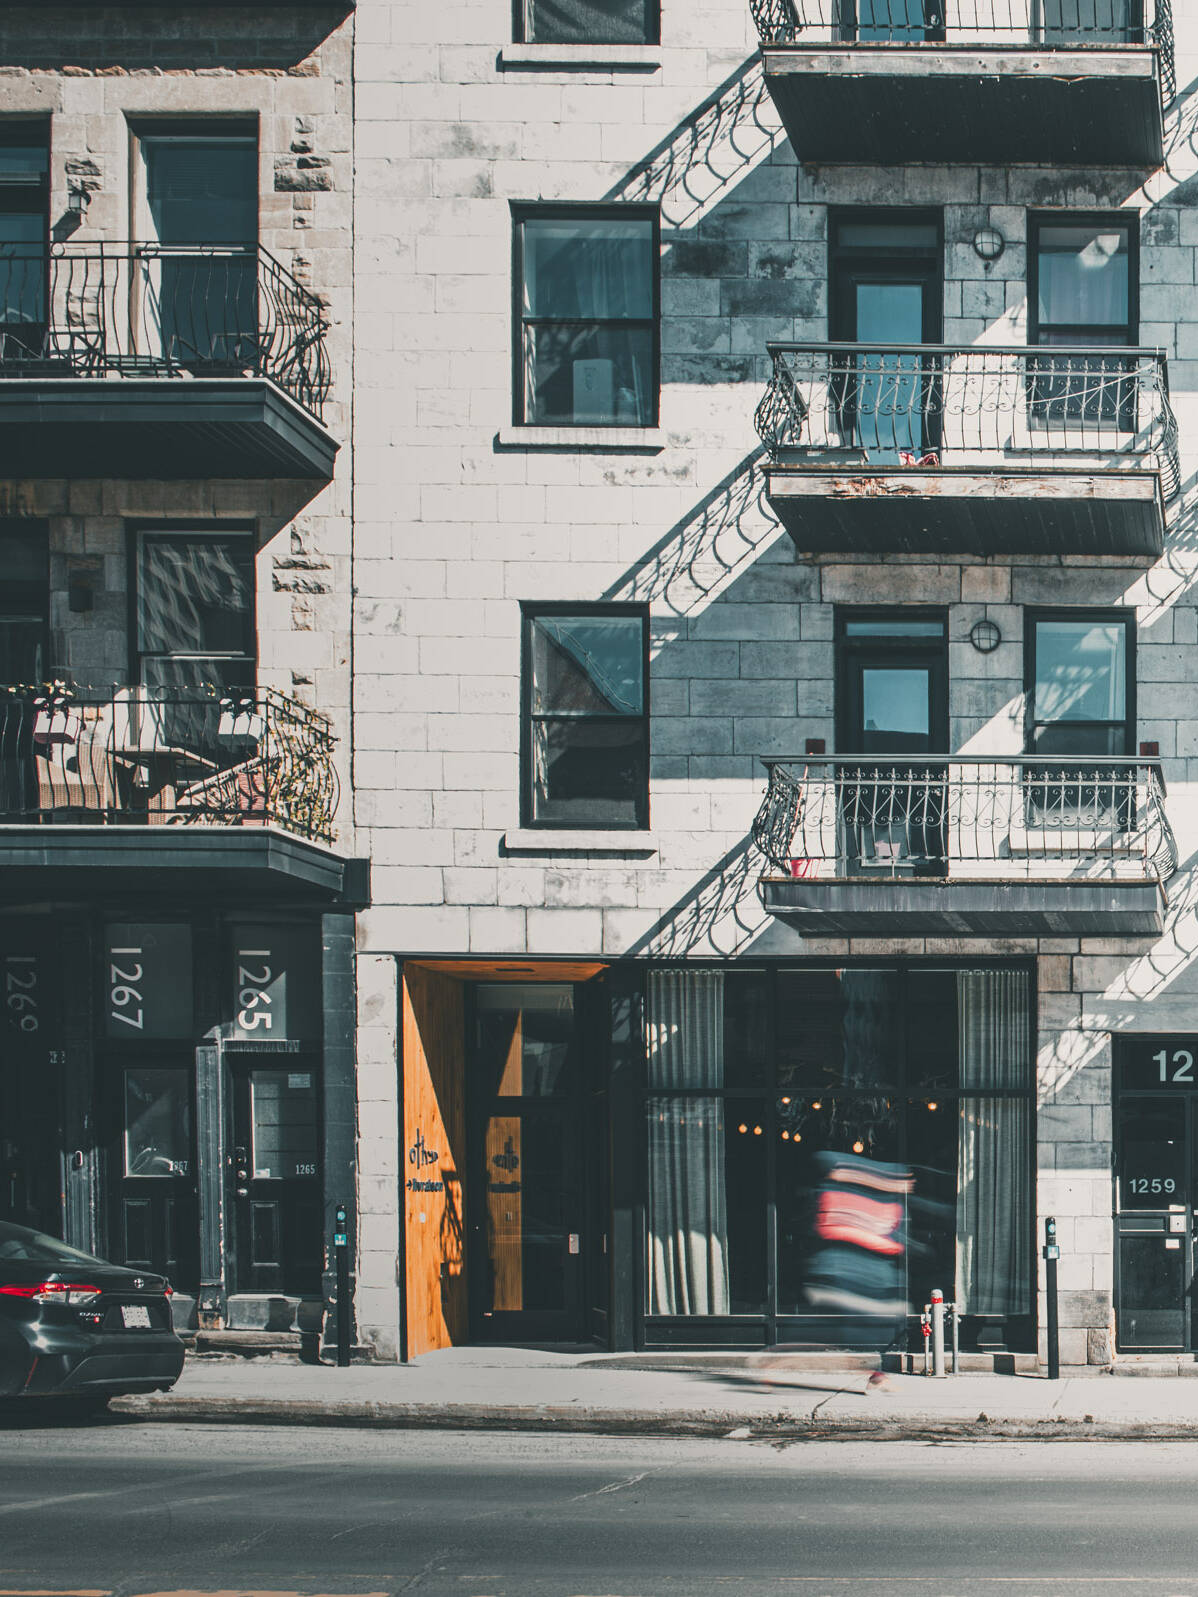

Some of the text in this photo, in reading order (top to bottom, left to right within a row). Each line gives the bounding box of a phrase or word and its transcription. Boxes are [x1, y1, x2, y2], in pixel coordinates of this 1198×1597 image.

[111, 947, 143, 1029] 1267
[239, 950, 272, 1031] 1265
[295, 1164, 316, 1175] 1265
[1129, 1178, 1176, 1194] 1259
